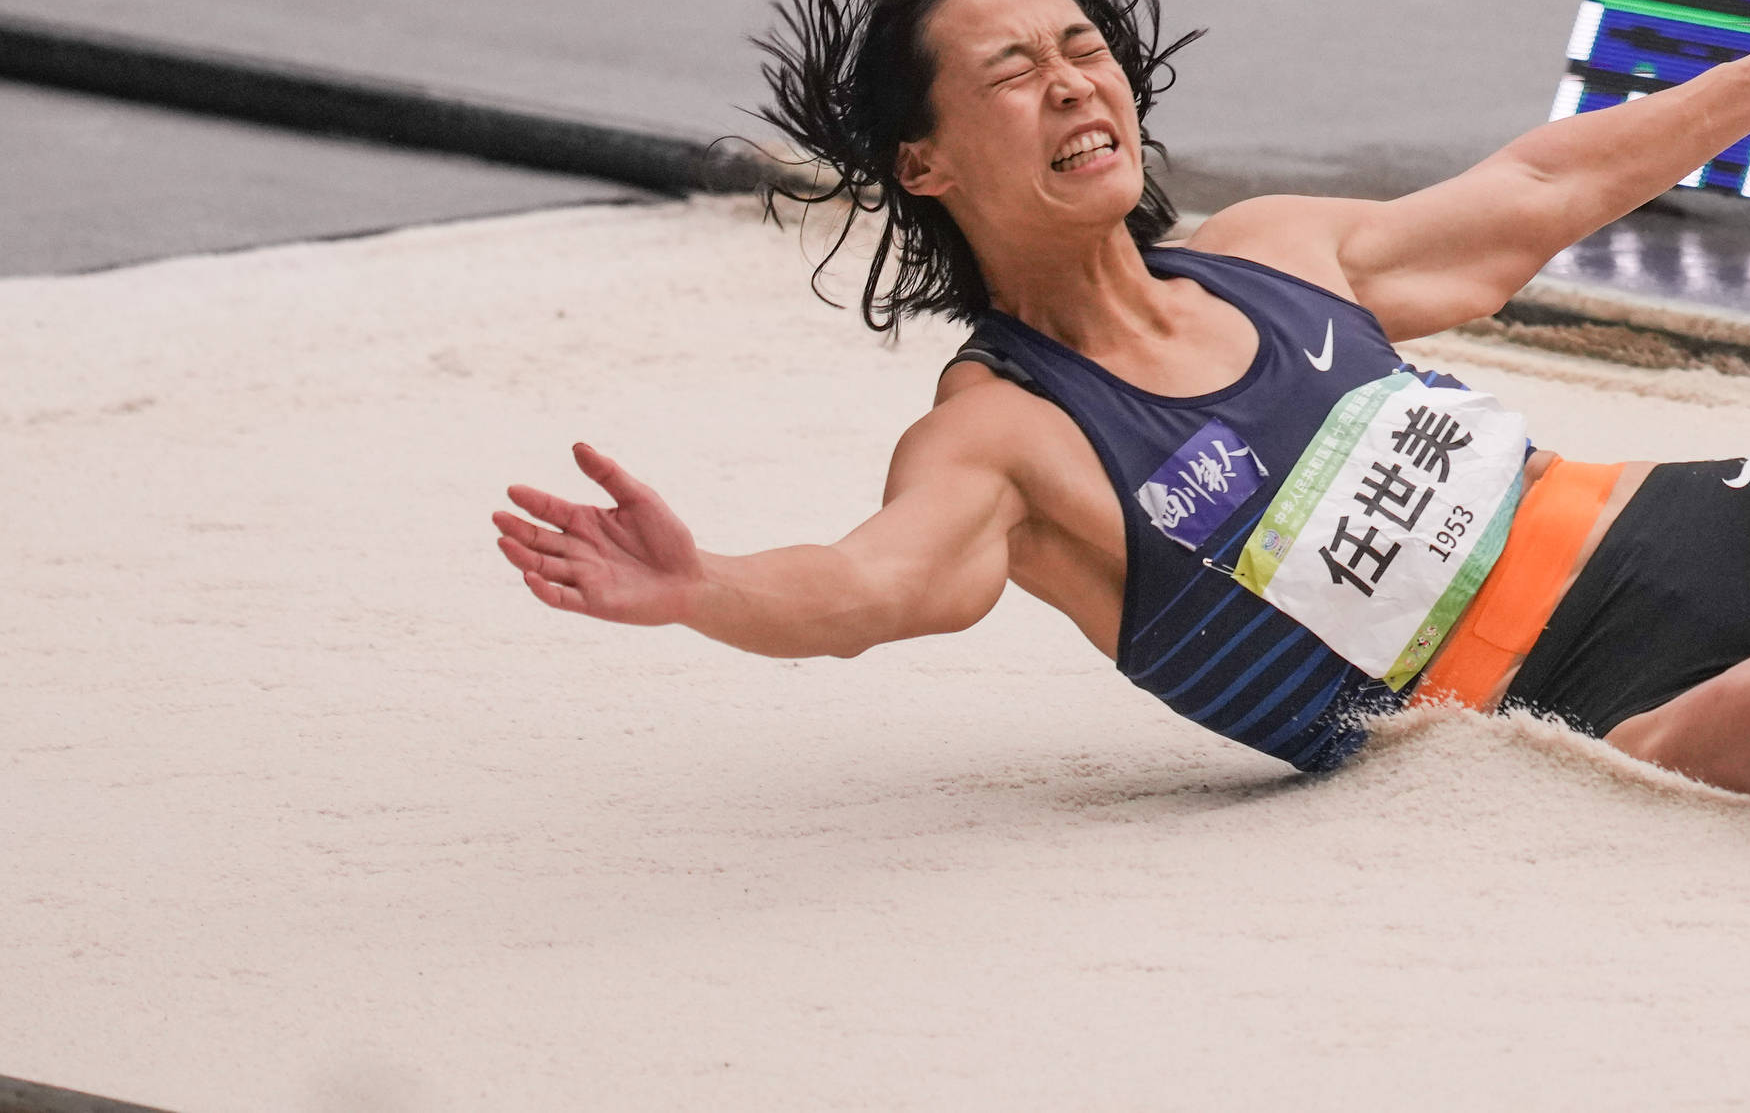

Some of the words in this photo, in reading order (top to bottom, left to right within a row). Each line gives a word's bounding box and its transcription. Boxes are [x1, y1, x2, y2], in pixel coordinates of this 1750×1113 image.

[1318, 405, 1474, 598] 任世美
[1428, 505, 1474, 564] 1953
